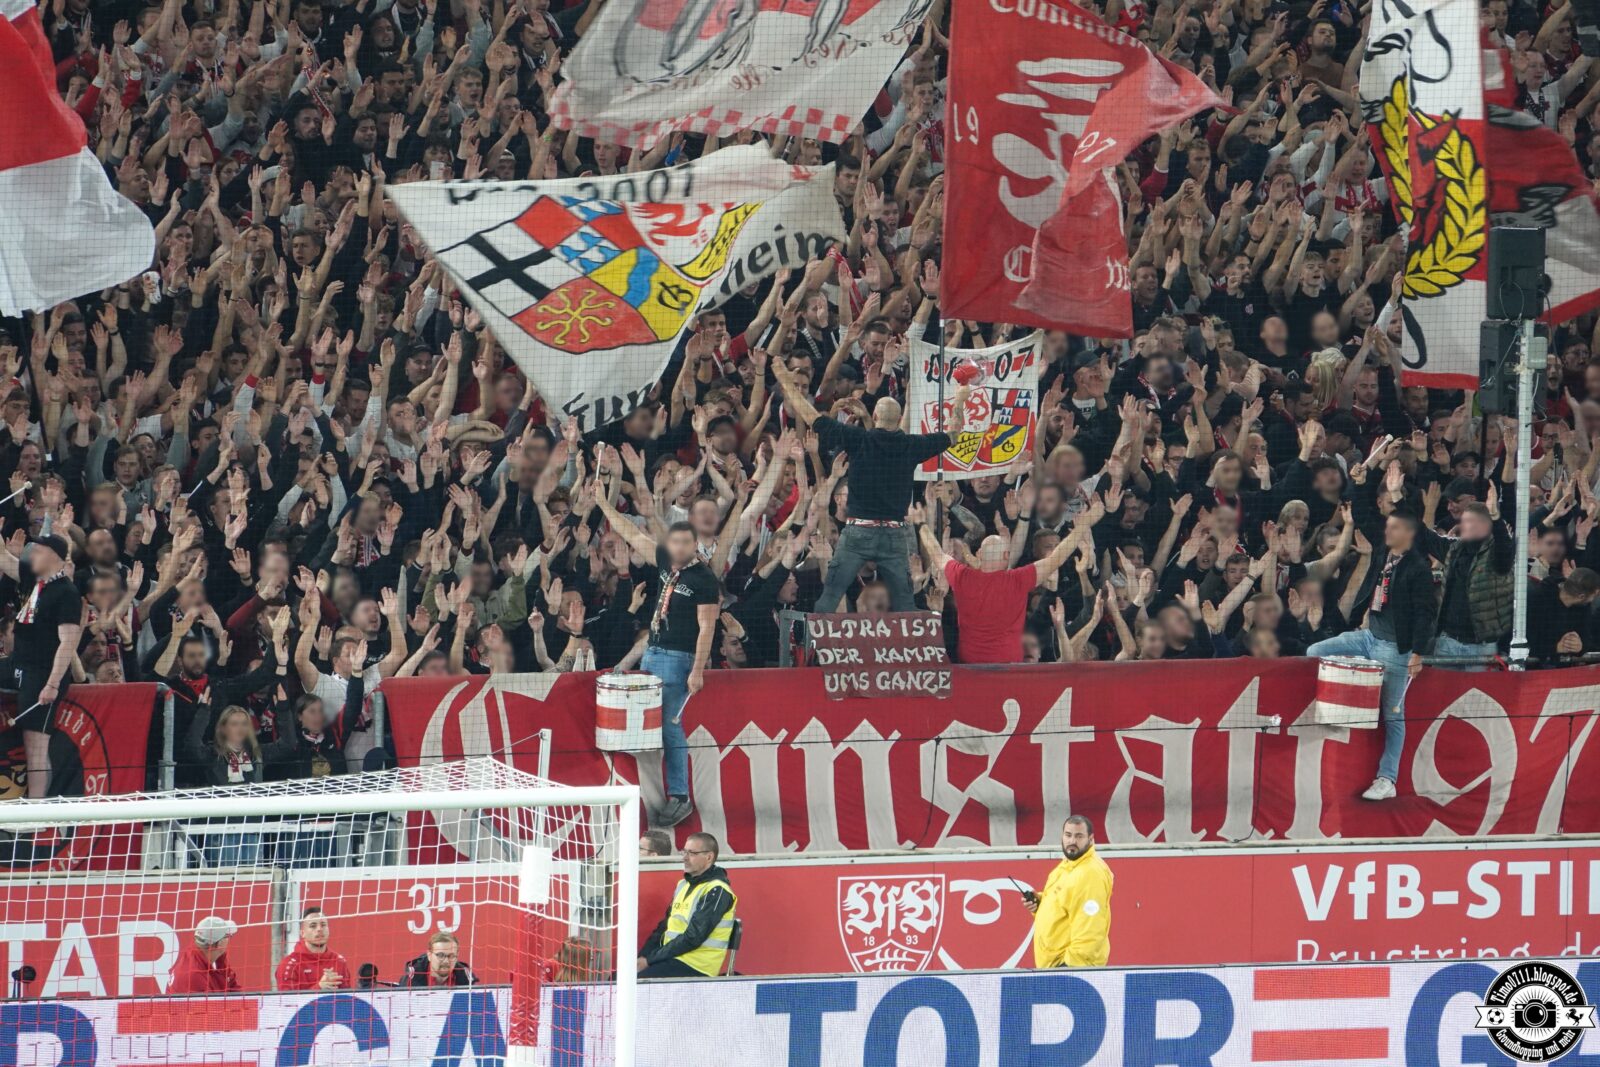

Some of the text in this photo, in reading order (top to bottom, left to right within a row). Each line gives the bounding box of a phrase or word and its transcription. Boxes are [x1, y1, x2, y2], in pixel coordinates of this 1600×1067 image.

[953, 103, 979, 146] 19
[816, 645, 947, 665] DER KAMPF
[824, 670, 951, 694] UMS GANZE
[1411, 686, 1600, 838] 97
[85, 772, 109, 796] 97
[407, 883, 462, 935] 35
[863, 935, 919, 947] 18 93
